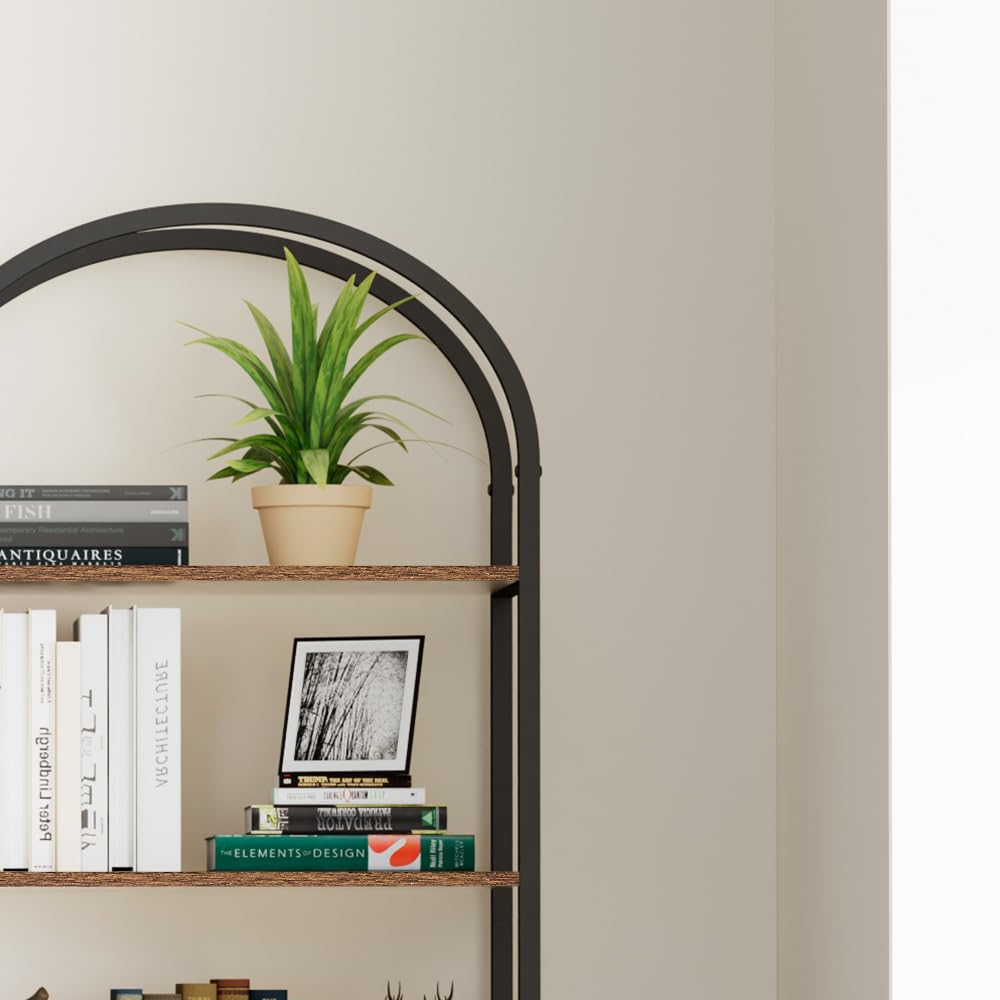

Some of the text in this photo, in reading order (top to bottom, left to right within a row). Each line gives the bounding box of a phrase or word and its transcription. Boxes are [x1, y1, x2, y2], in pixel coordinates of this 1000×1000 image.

[19, 488, 36, 498] IT
[4, 503, 52, 520] FISH
[317, 816, 392, 831] PREDATOR
[234, 848, 301, 858] ELEMENTS
[313, 848, 365, 858] DESIGN
